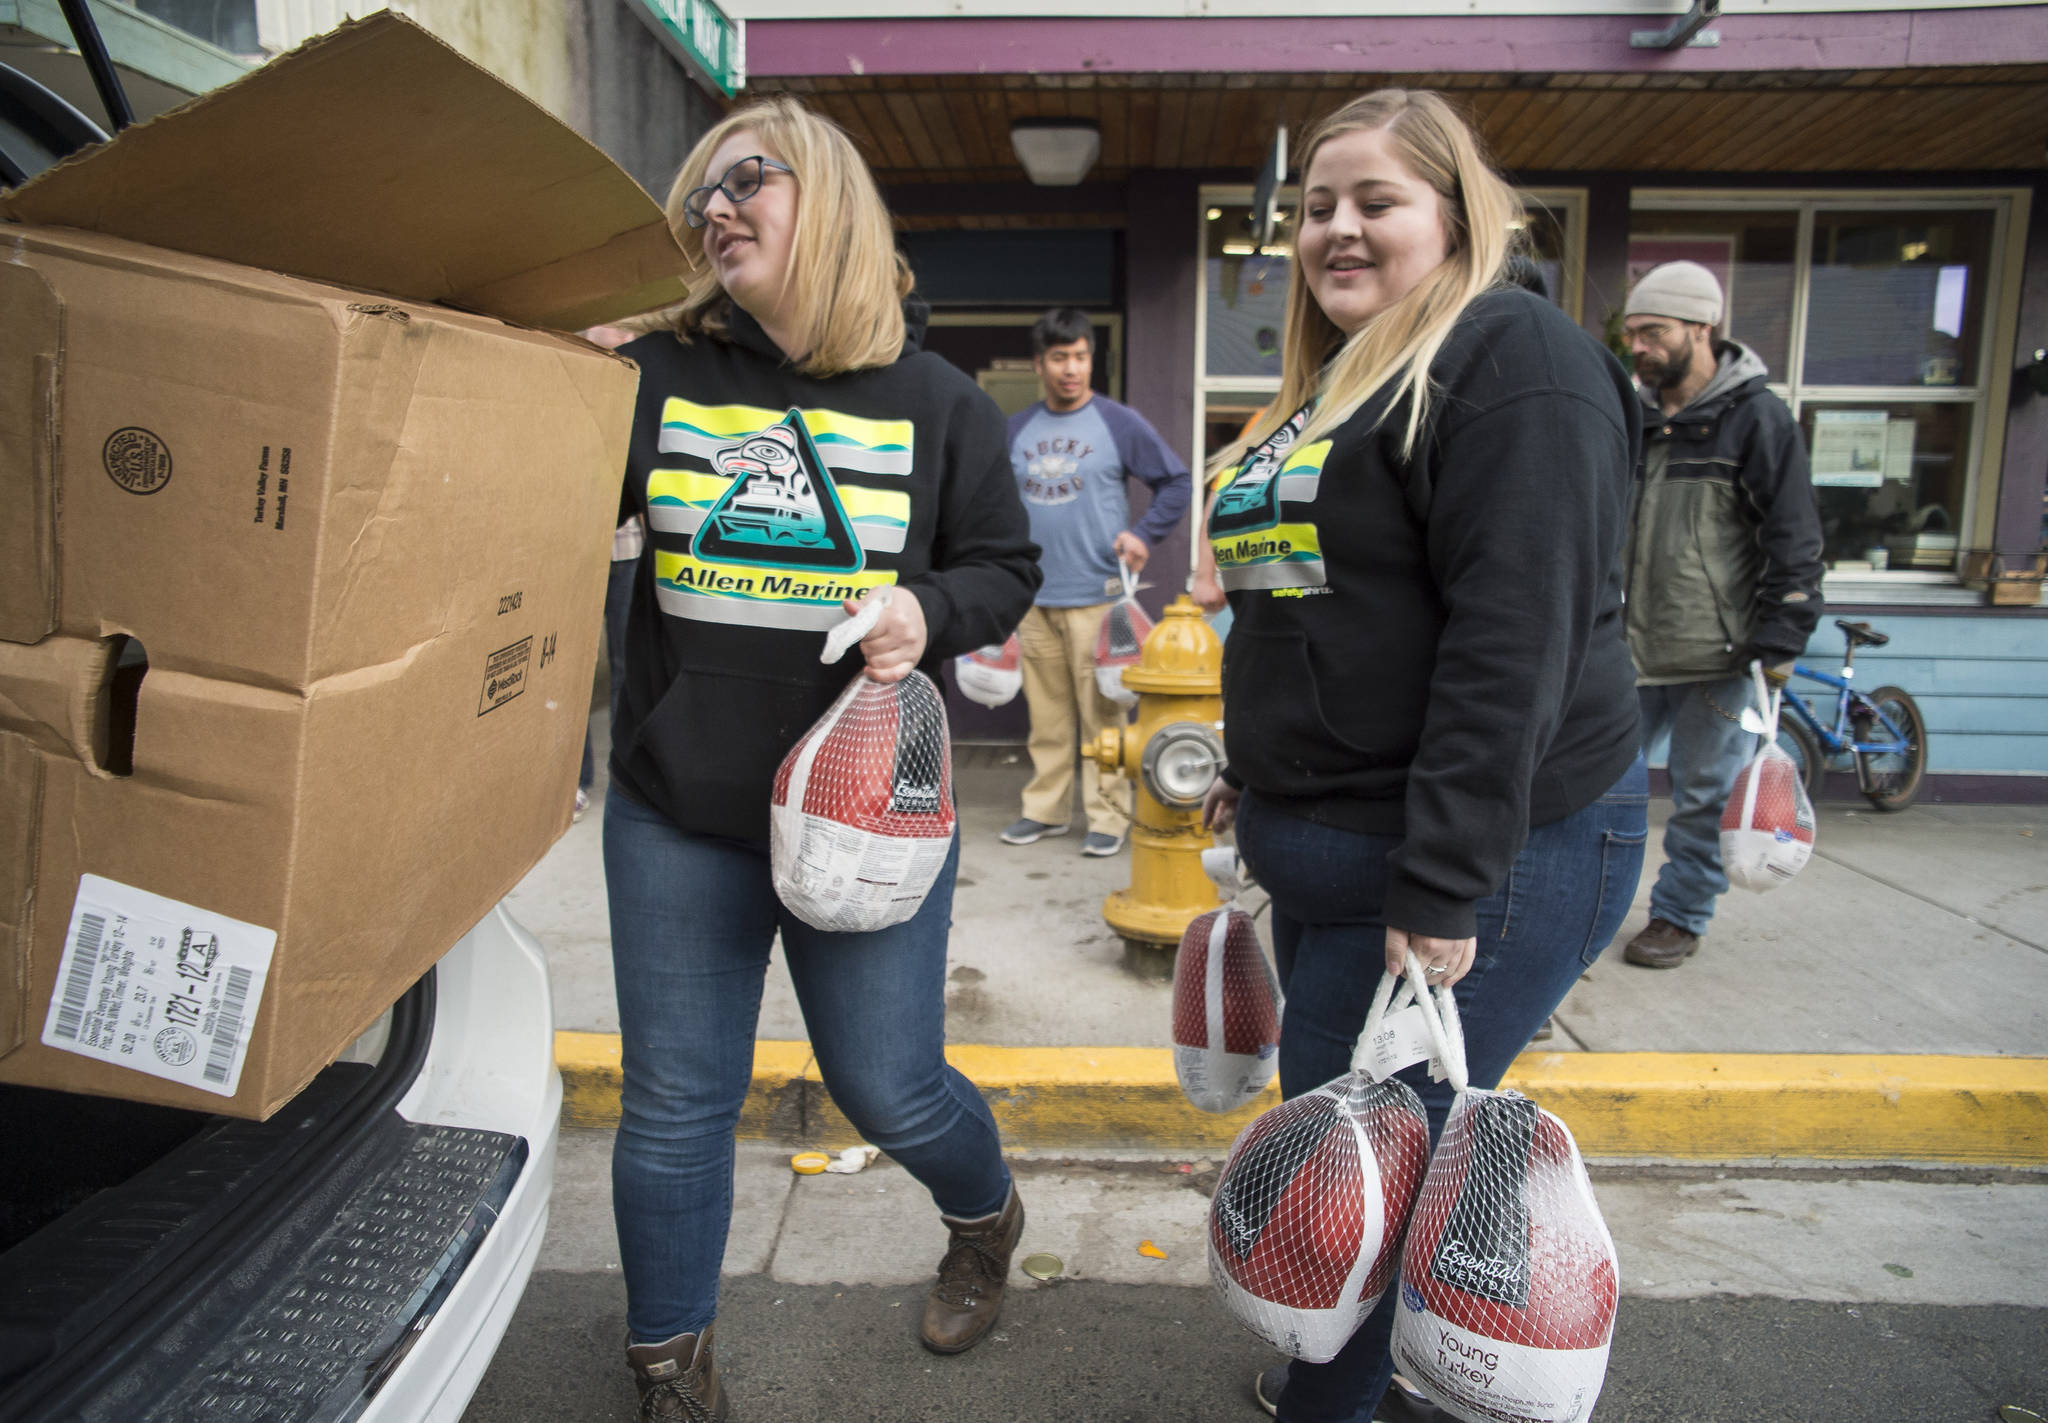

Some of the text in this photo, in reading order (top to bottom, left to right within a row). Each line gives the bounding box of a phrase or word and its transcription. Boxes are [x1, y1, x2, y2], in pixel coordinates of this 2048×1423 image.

[1023, 438, 1094, 460] LUCKY
[254, 446, 269, 523] Turkey Valley Farms
[674, 566, 870, 600] Allen Marine
[895, 779, 940, 798] Essential
[191, 944, 208, 956] A
[94, 987, 112, 1017] Everyday
[87, 1018, 102, 1047] Essential
[1440, 1240, 1522, 1282] Essential
[1439, 1262, 1519, 1296] EVERYDAY
[1439, 1327, 1499, 1370] Young
[1436, 1349, 1495, 1388] Turkey
